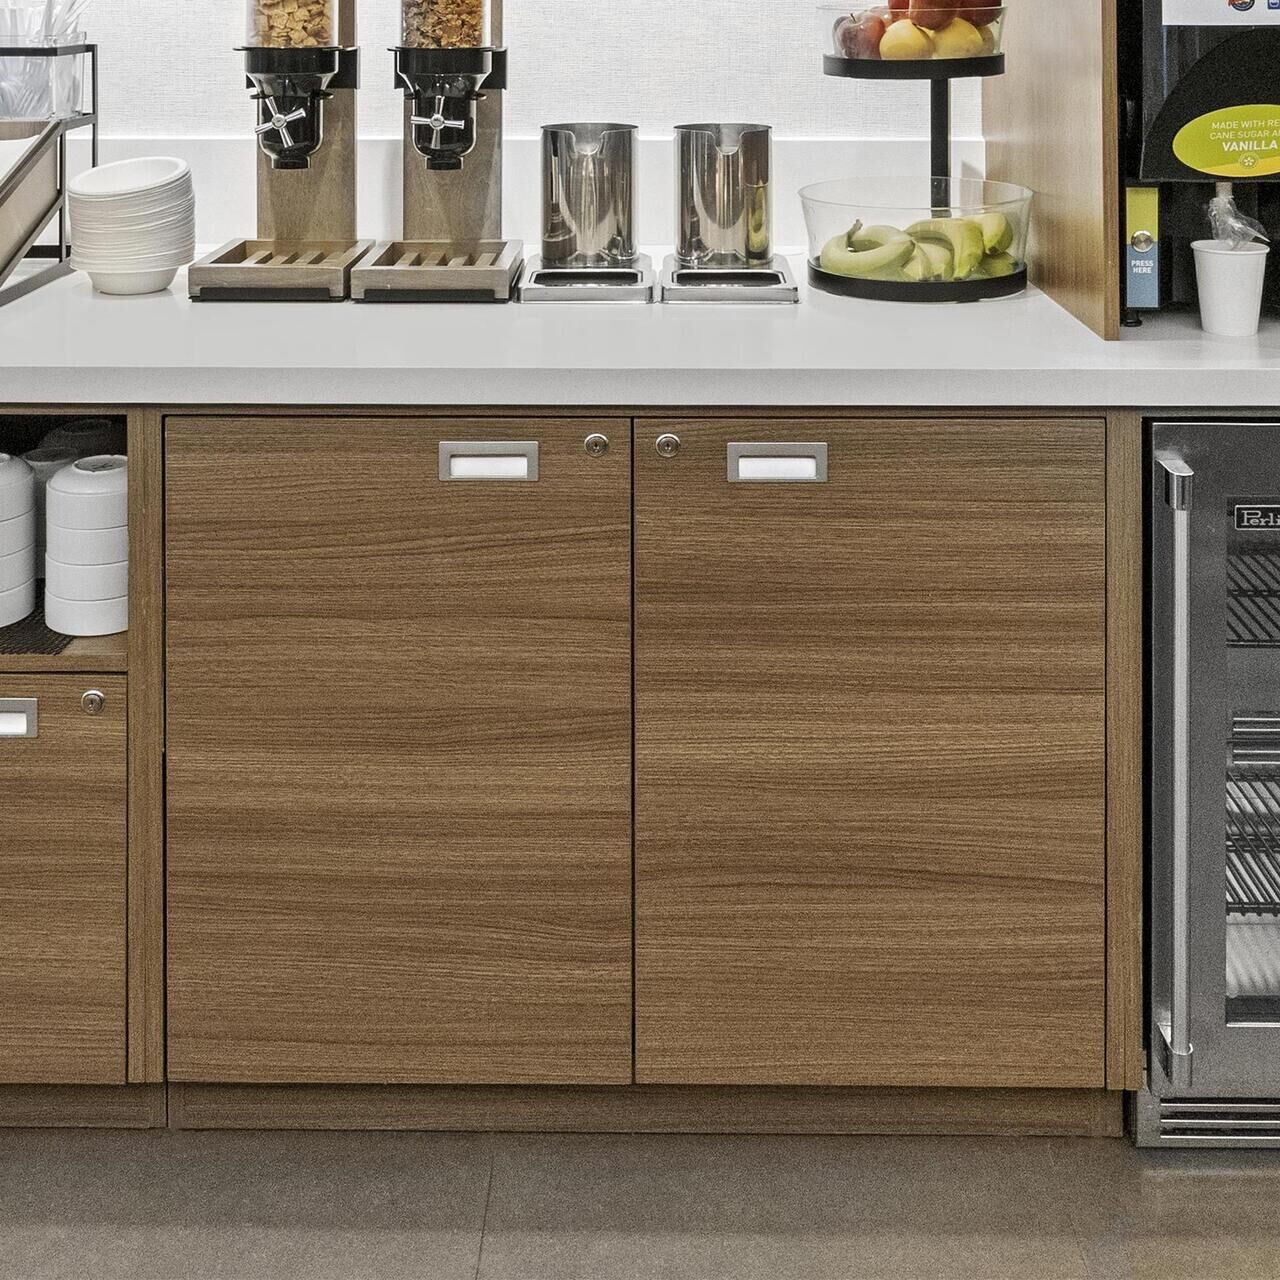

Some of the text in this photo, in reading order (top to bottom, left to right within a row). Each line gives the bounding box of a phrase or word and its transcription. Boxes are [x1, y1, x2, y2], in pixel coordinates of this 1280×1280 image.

[1211, 120, 1239, 130] MADE
[1240, 119, 1265, 129] WITH
[1209, 131, 1237, 140] CANE
[1237, 129, 1270, 139] SUGAR
[1222, 139, 1279, 152] VANILLA
